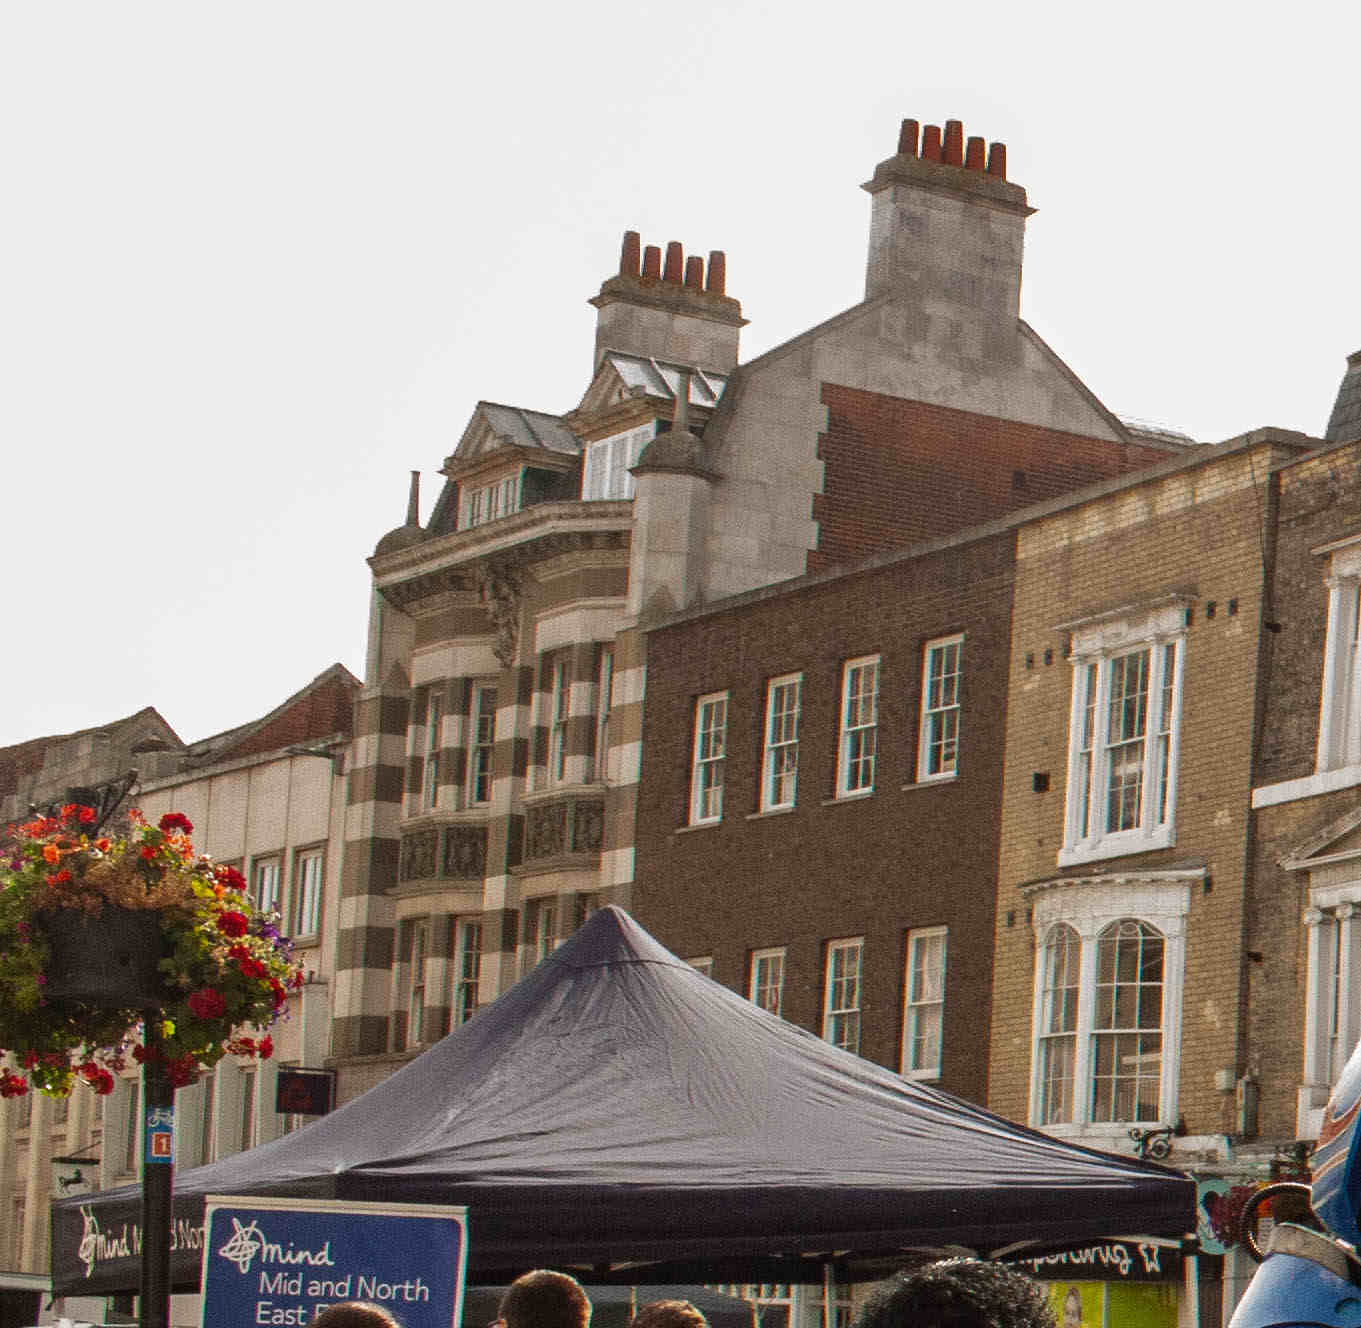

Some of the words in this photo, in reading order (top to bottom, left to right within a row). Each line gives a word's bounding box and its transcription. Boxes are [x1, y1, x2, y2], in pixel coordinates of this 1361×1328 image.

[262, 1241, 335, 1266] mind
[258, 1271, 303, 1296] Mid
[307, 1273, 351, 1299] and
[356, 1275, 430, 1302] North
[255, 1301, 308, 1326] East
